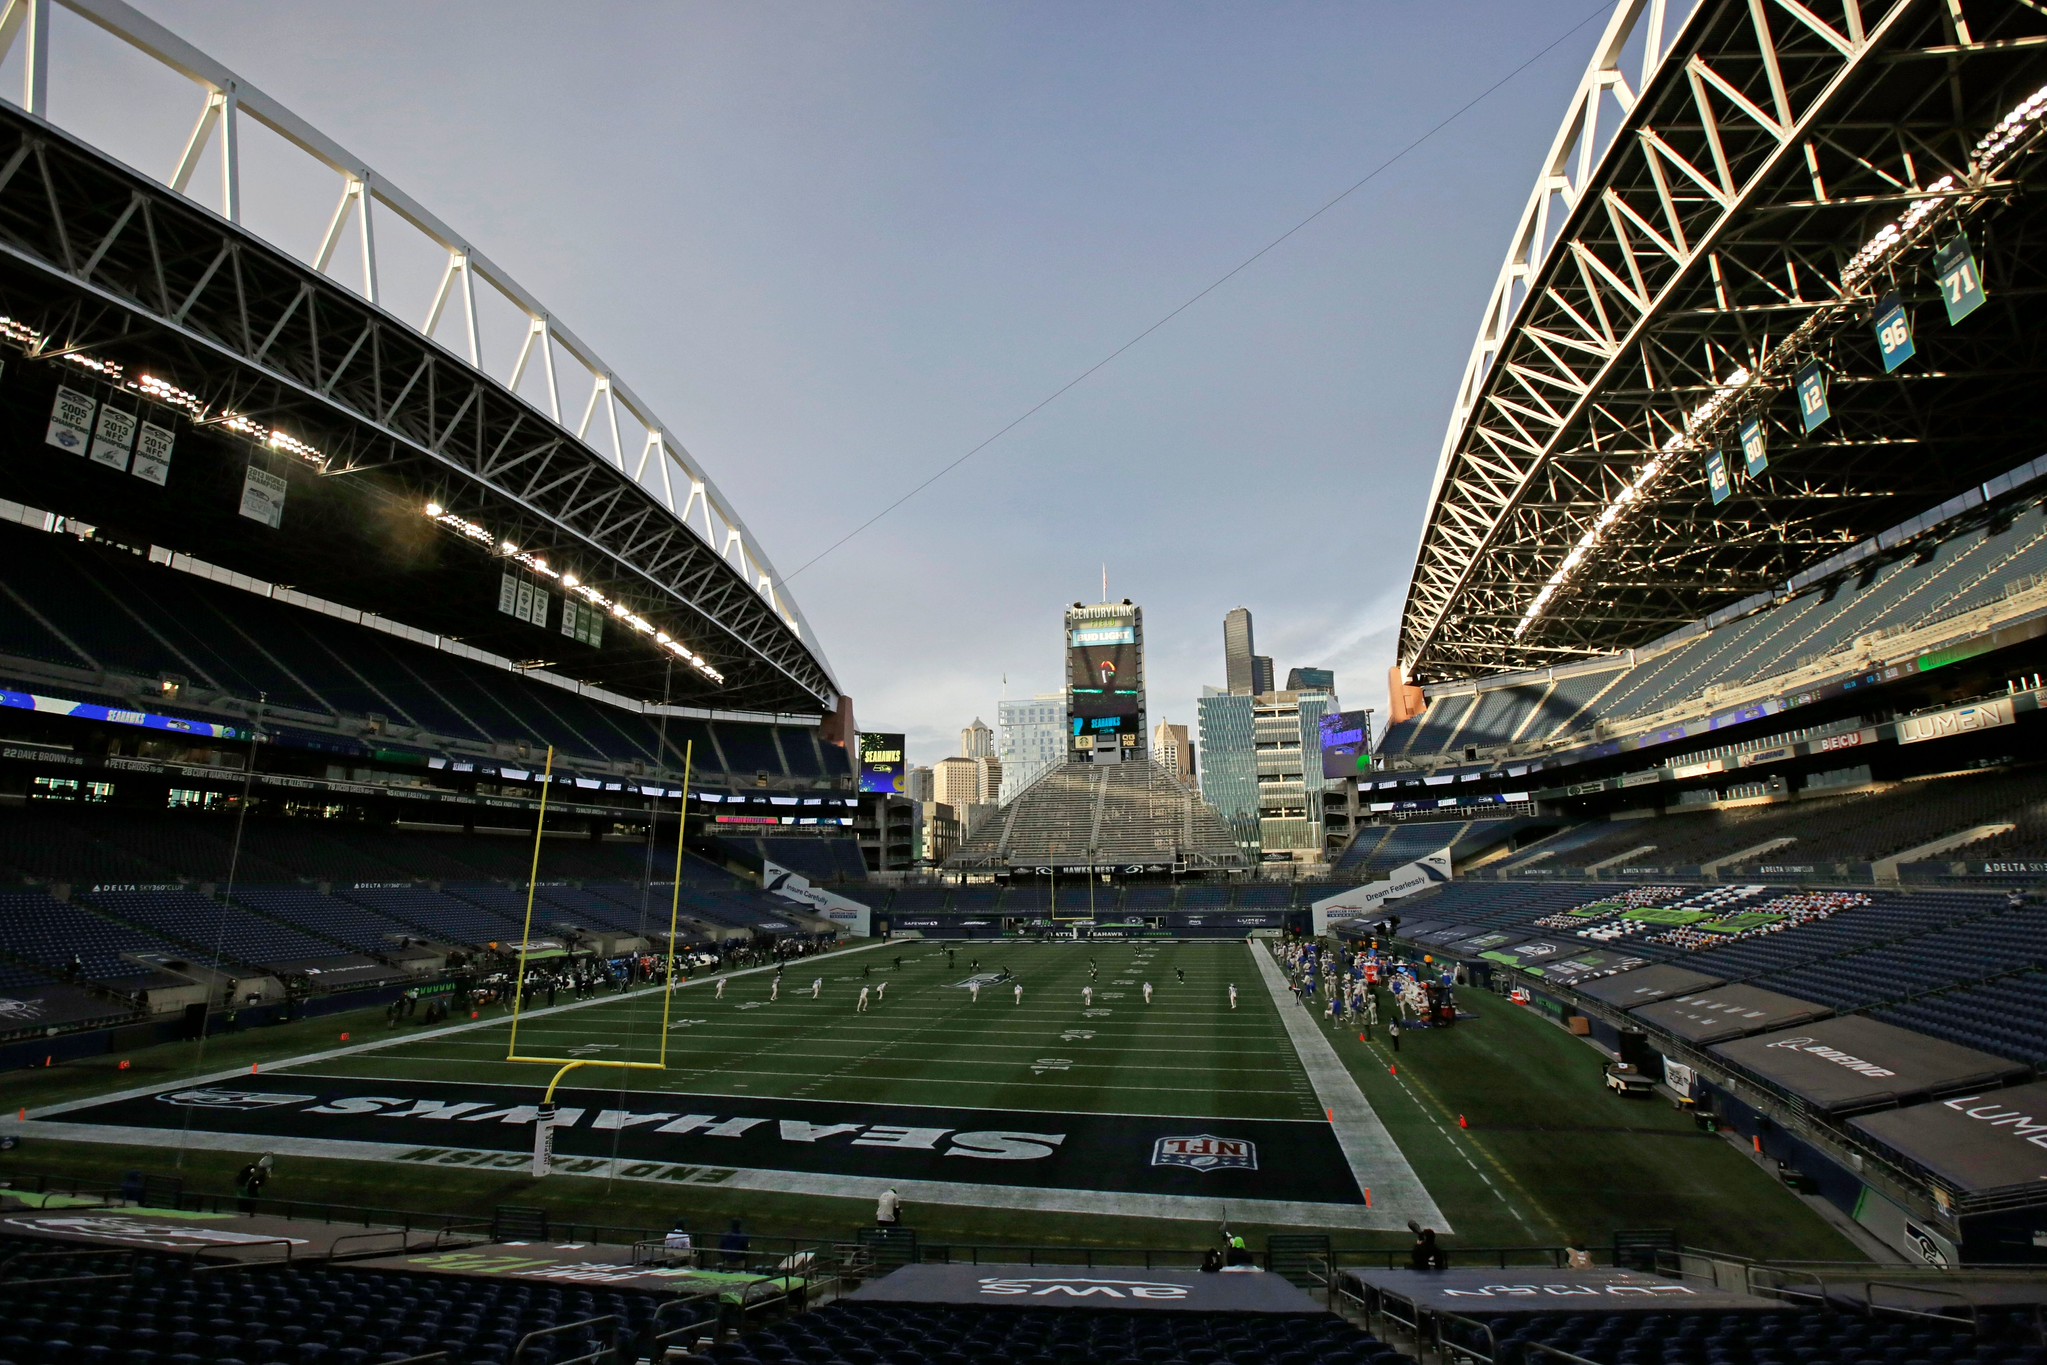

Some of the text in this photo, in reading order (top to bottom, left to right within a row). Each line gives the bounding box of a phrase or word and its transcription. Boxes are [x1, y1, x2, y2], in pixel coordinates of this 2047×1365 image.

[1945, 264, 1975, 304] 71
[1880, 318, 1908, 354] 96
[1803, 385, 1823, 415] 12
[61, 401, 87, 419] 2005
[63, 412, 82, 425] NFC
[104, 420, 128, 436] 2013
[105, 429, 123, 442] NFC
[144, 435, 167, 452] 2014
[146, 446, 163, 459] NFC
[1745, 441, 1763, 464] 80
[1711, 468, 1725, 491] 45
[1073, 605, 1132, 620] CENTURYLINK
[1077, 631, 1130, 642] BUD LIGHT
[106, 710, 146, 726] SEAHAWKS
[1091, 717, 1121, 728] SEAHAWKS
[1902, 703, 2003, 742] LUMEN
[1821, 732, 1860, 751] BECU
[3, 748, 17, 758] 22
[17, 749, 37, 760] DAVE
[38, 751, 66, 763] BROWN
[865, 750, 901, 762] SEAHAWKS
[109, 759, 125, 770] PETE
[127, 761, 149, 773] GROSS
[1063, 866, 1091, 874] HAWKS
[1993, 863, 2027, 872] DELTA
[103, 884, 136, 892] DELTA
[787, 884, 828, 905] Insure Carefully
[1366, 876, 1425, 901] Dream Fearlessly
[1803, 1045, 1896, 1077] BOEING
[300, 1096, 1067, 1160] SEAHAWKS
[1168, 1139, 1244, 1155] NFL
[394, 1148, 737, 1182] END RACISM
[980, 1284, 1188, 1299] aws
